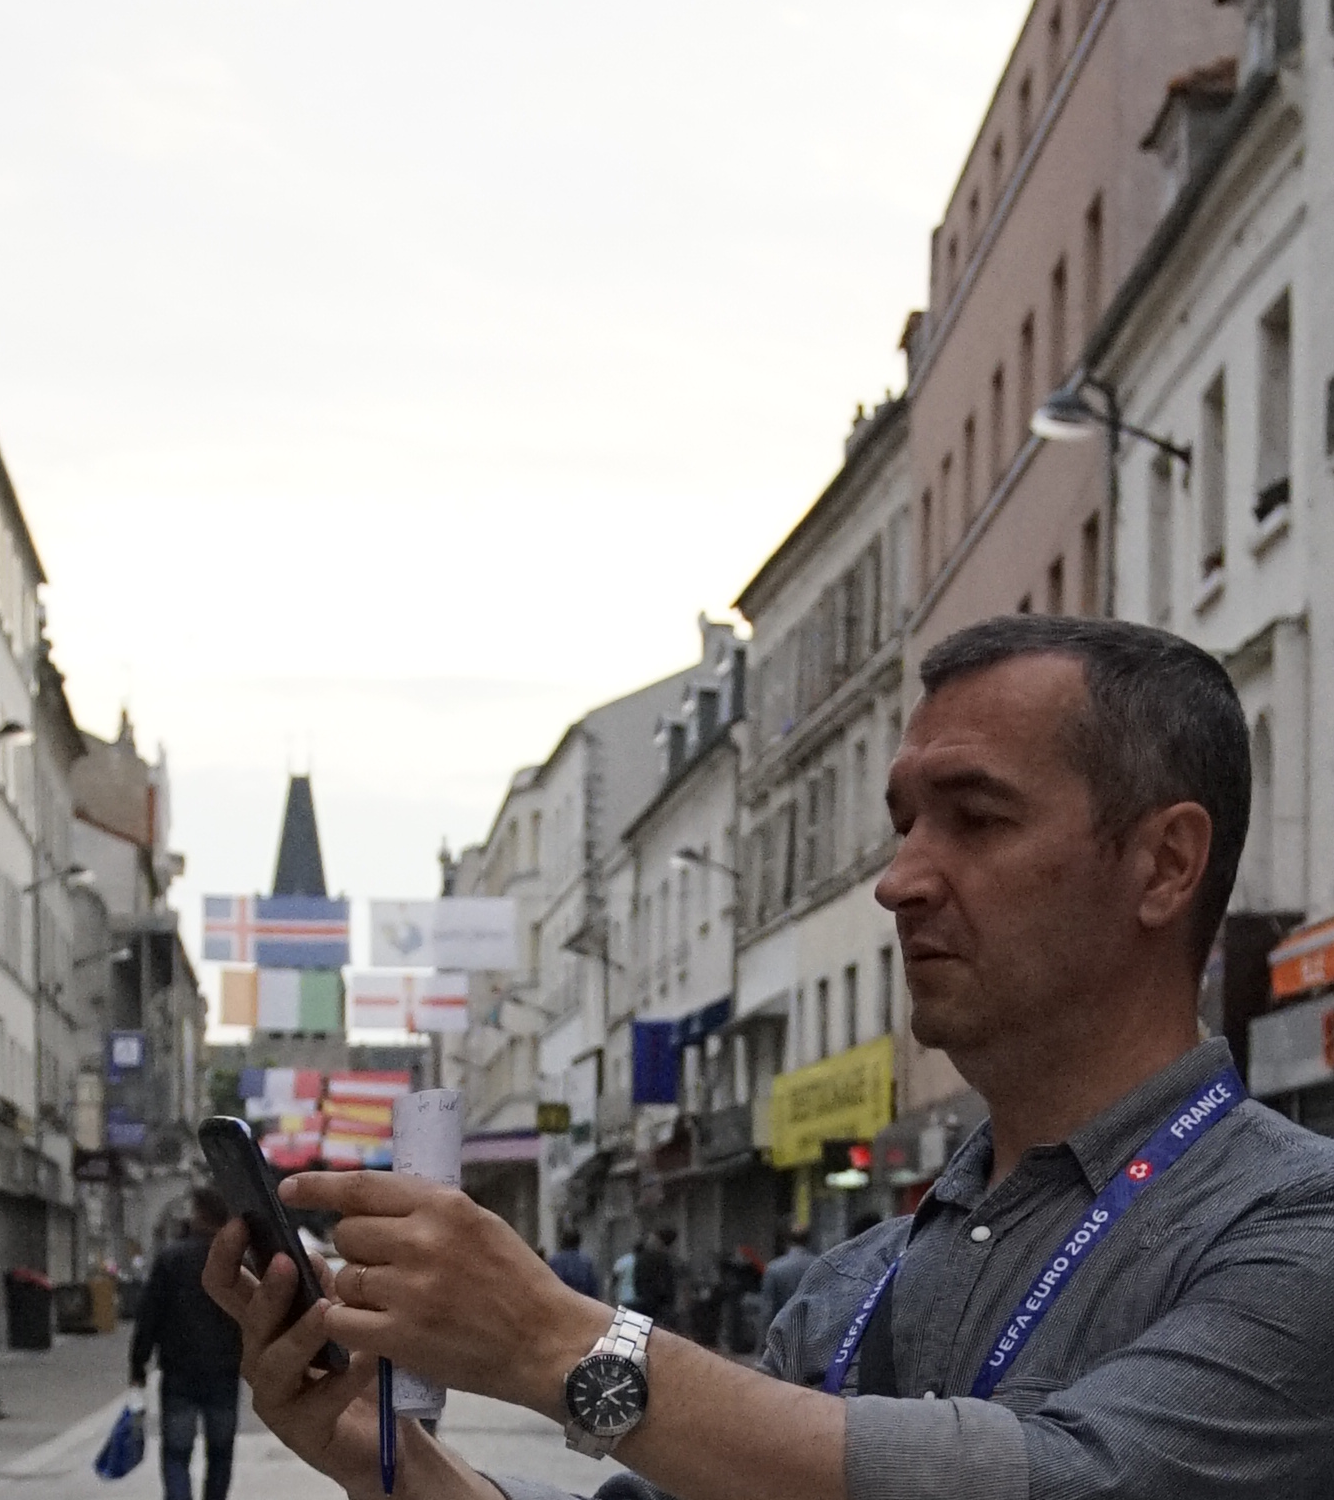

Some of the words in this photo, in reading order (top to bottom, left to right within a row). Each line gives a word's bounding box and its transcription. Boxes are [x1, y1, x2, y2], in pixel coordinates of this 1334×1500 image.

[989, 1314, 1032, 1367] UEFA
[1026, 1257, 1069, 1312] EURO
[1065, 1208, 1109, 1257] 2016
[1170, 1082, 1231, 1139] FRANCE
[835, 1312, 868, 1364] UEFA
